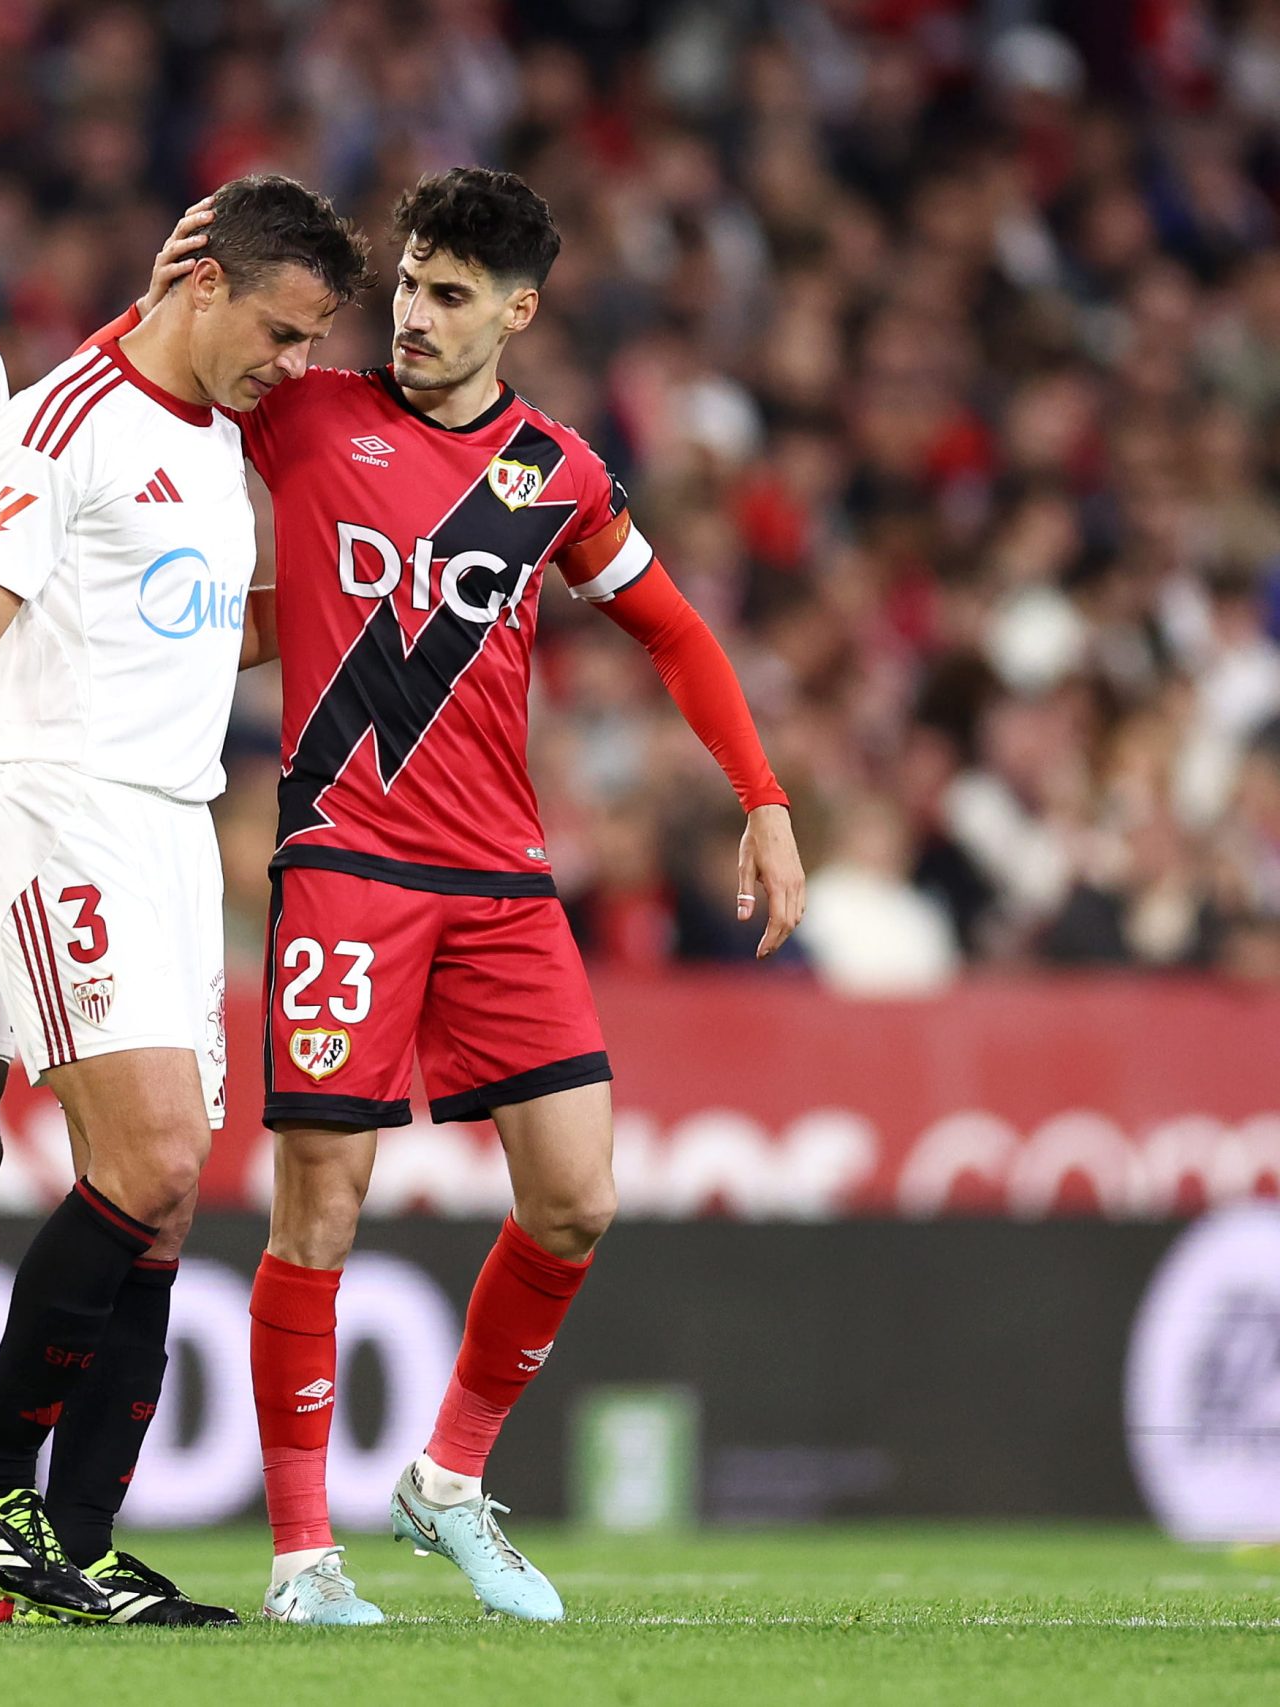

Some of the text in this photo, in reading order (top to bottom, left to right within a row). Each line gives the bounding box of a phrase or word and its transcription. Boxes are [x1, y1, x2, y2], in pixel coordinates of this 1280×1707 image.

[351, 452, 389, 468] umbro
[336, 520, 535, 631] DIGI
[58, 883, 109, 964] 3
[282, 936, 376, 1025] 23
[44, 1344, 96, 1369] SFC
